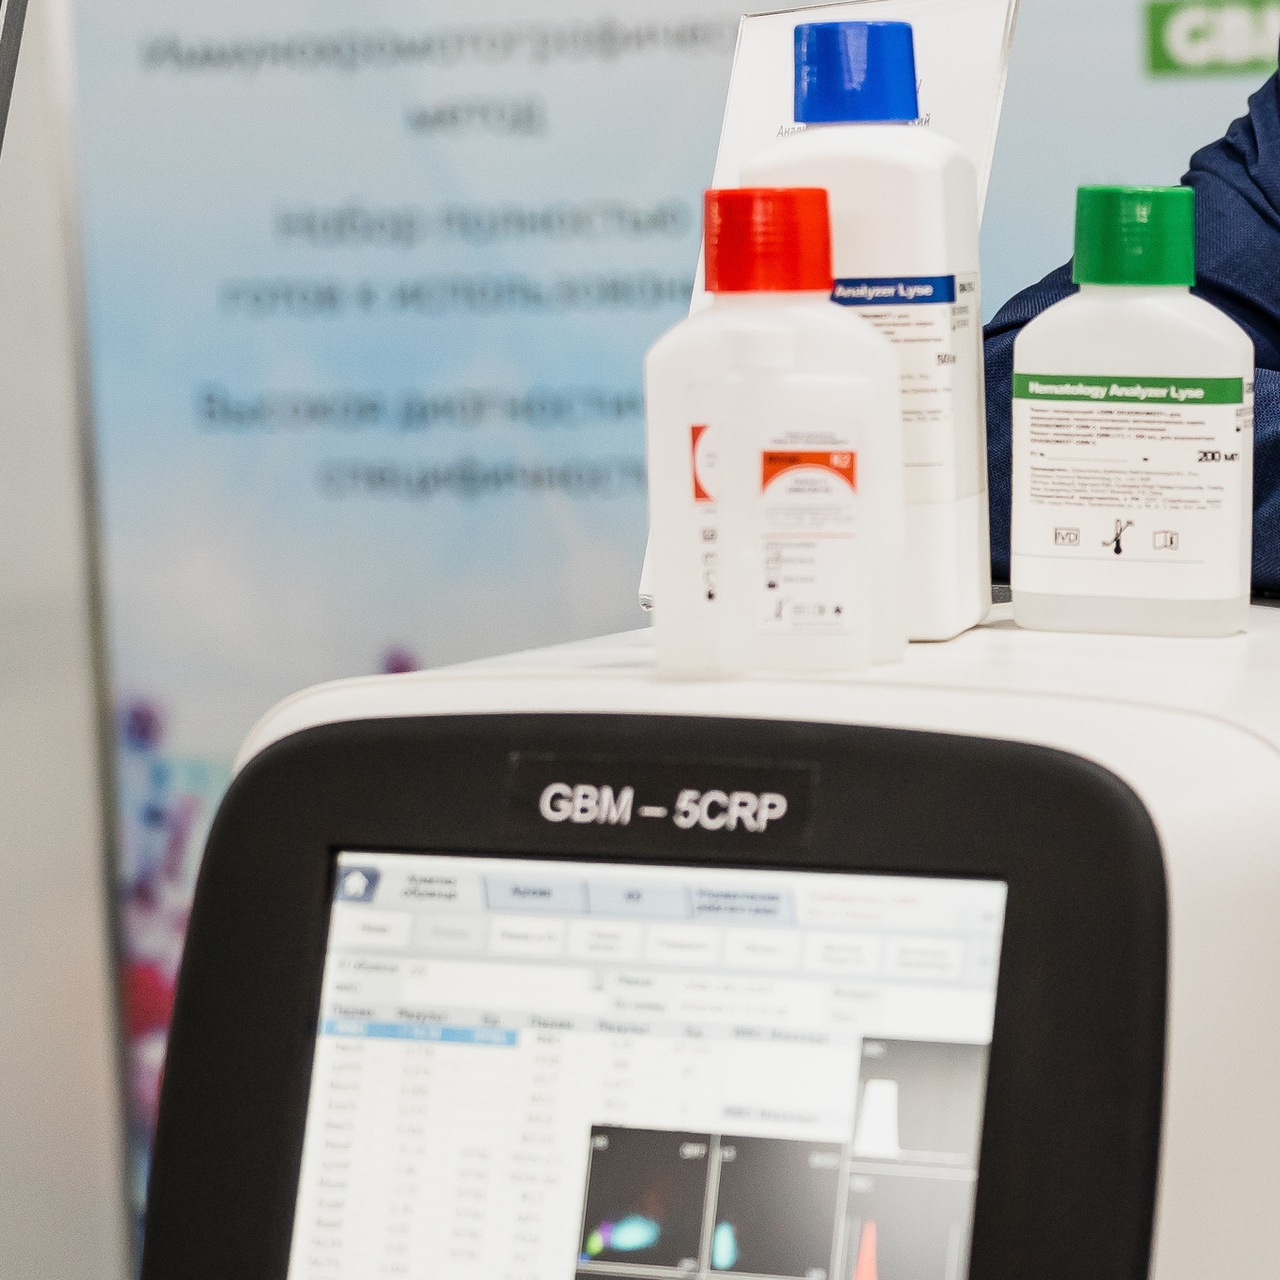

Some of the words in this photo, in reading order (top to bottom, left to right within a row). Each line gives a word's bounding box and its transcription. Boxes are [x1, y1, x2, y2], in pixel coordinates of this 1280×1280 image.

[898, 282, 933, 299] Lyse
[1109, 383, 1168, 400] Analyzer
[1170, 386, 1205, 401] Lyse
[1198, 450, 1222, 463] 200
[539, 782, 634, 826] GBM
[673, 788, 788, 833] 5CRP
